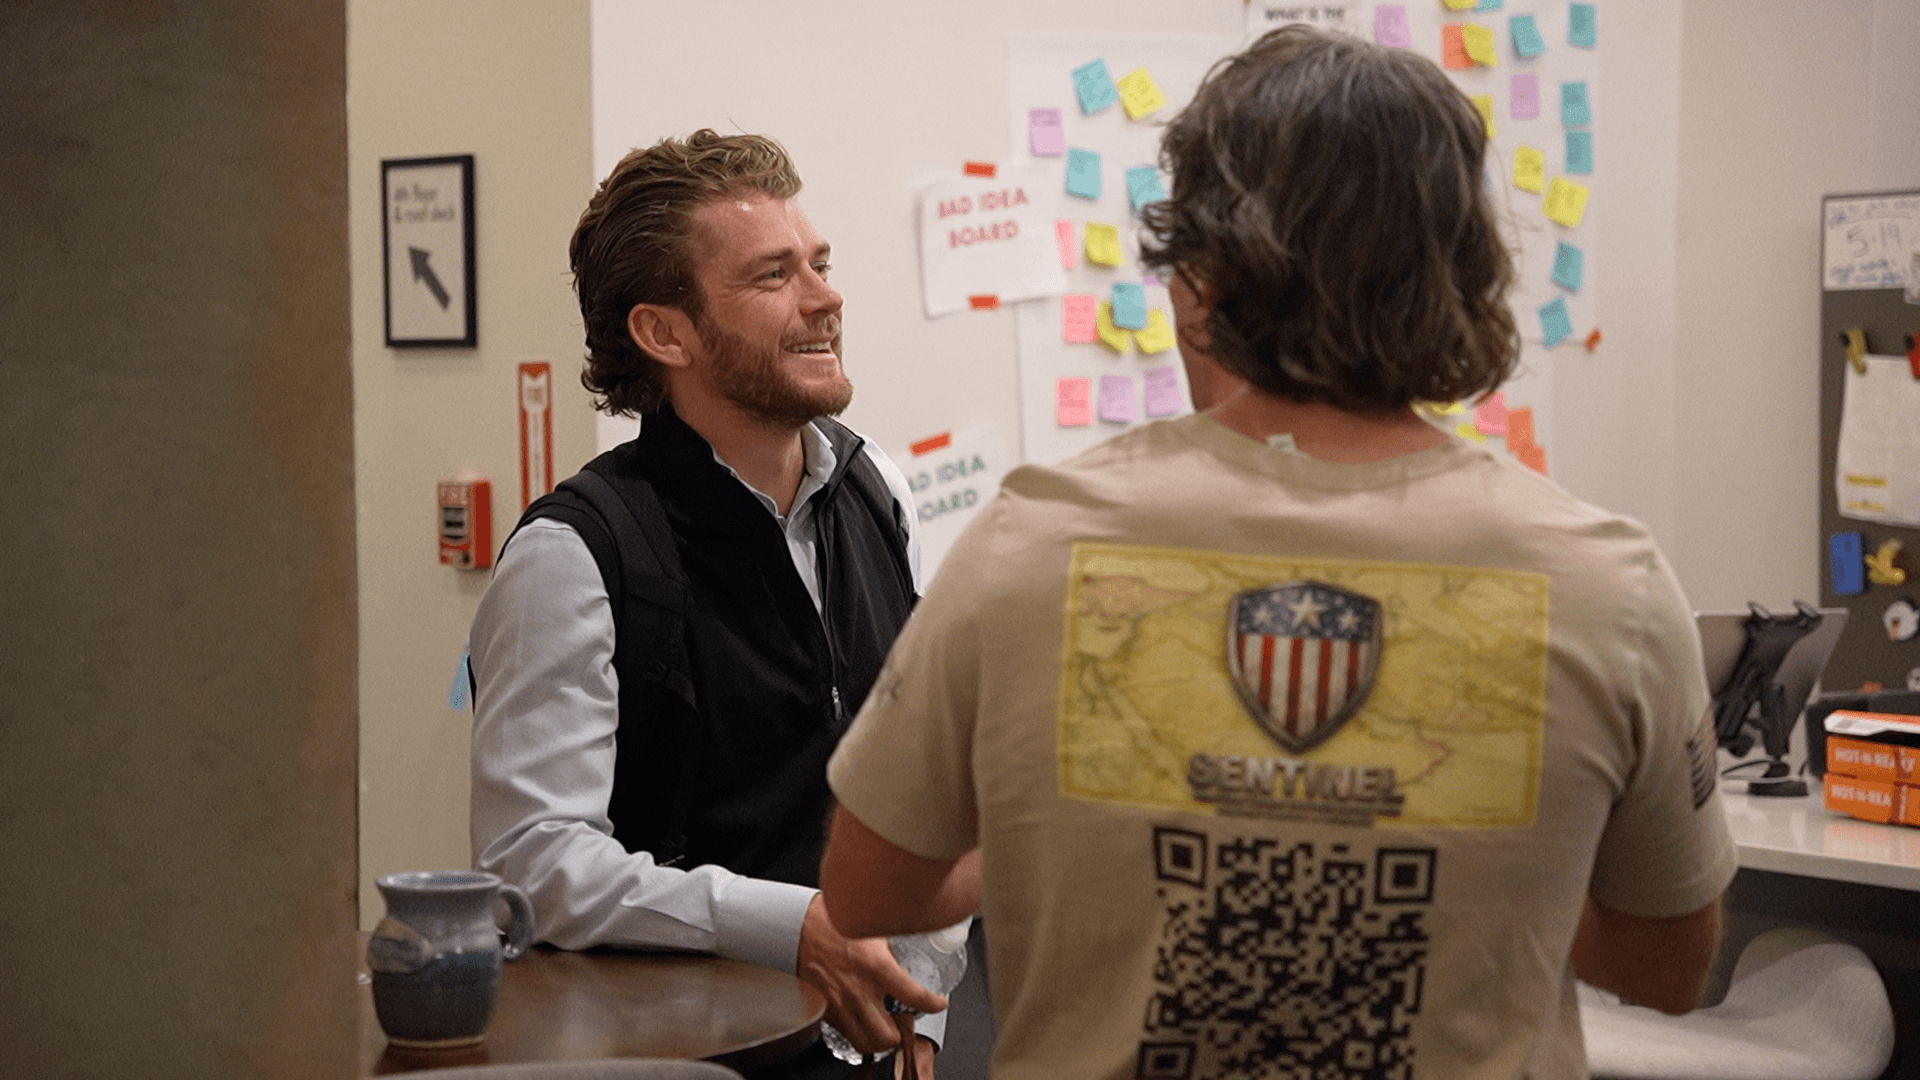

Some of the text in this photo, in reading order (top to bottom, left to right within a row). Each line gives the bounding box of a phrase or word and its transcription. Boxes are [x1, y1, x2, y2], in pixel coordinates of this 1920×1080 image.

[938, 187, 1029, 219] BAD IDEA
[949, 219, 1019, 249] BOARD
[908, 455, 986, 493] AD IDEA
[917, 489, 978, 521] OARD
[1187, 752, 1402, 801] SENTINEL
